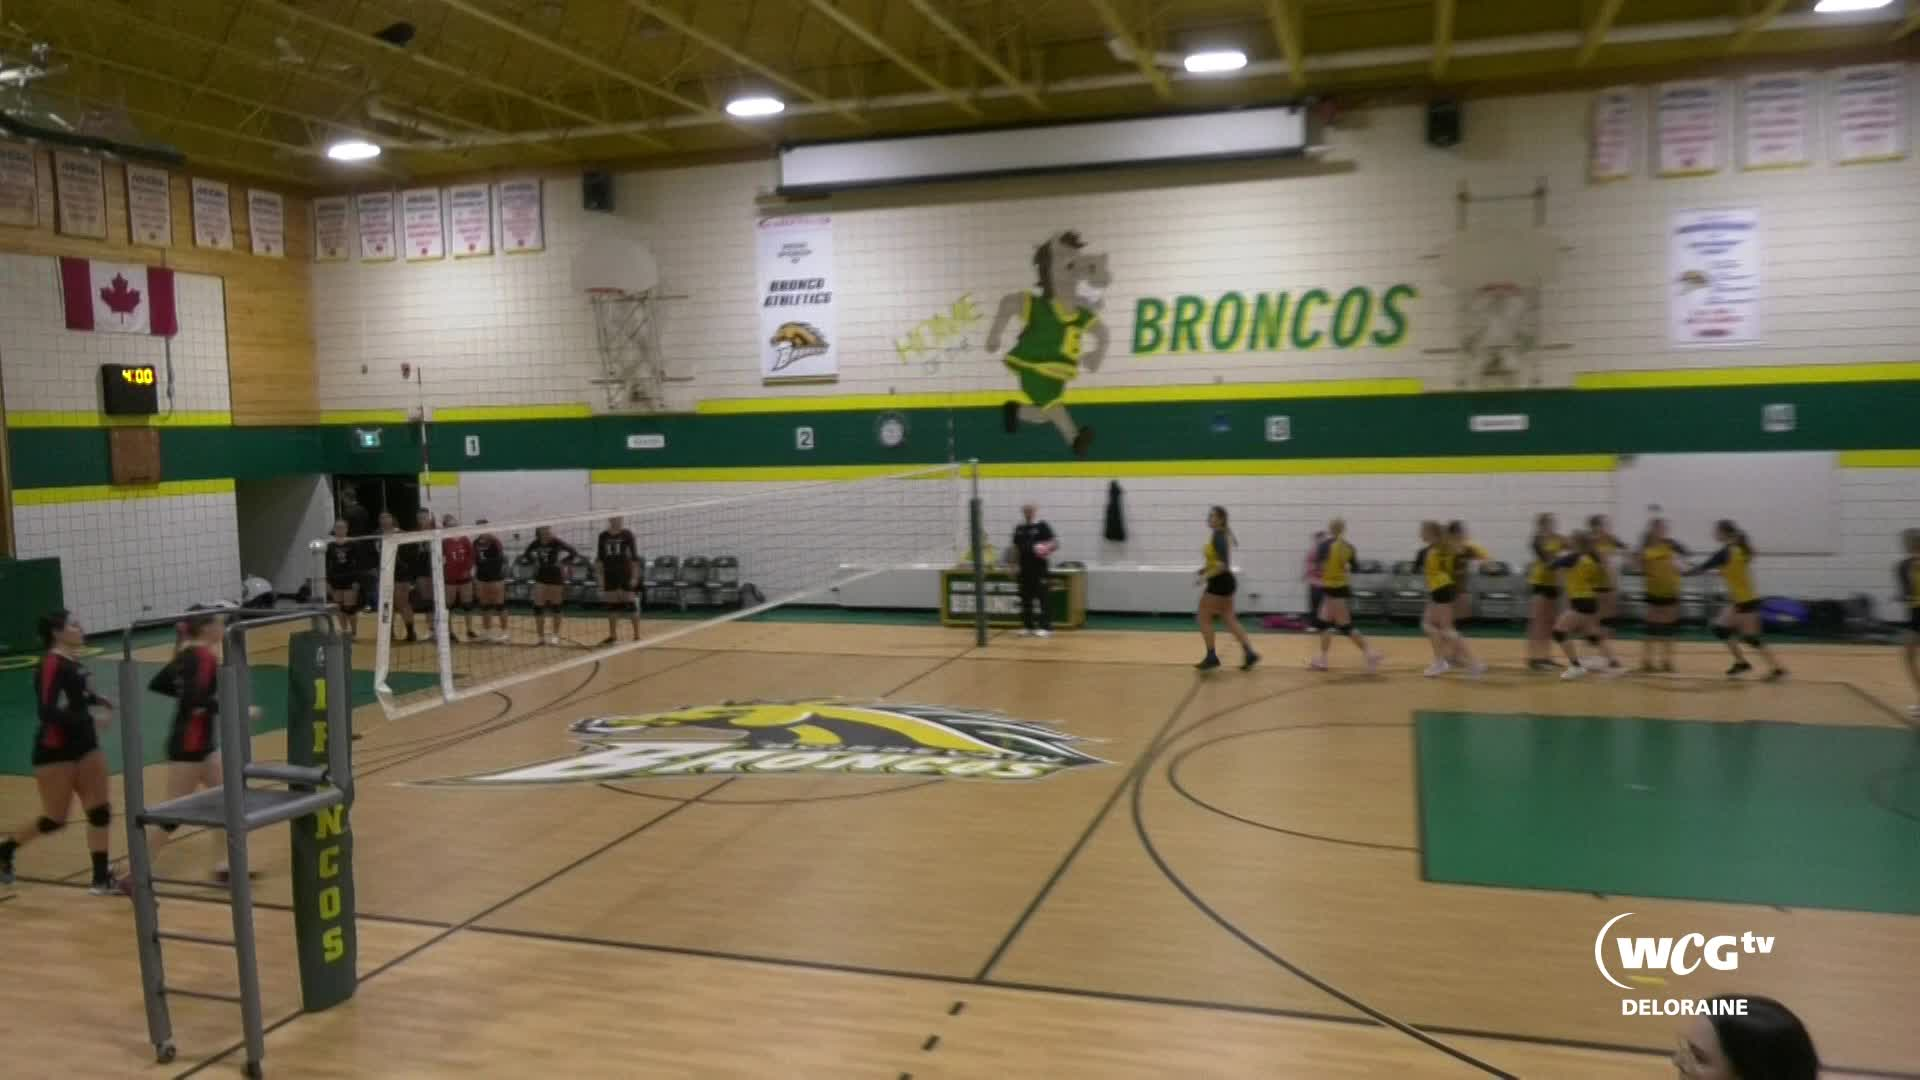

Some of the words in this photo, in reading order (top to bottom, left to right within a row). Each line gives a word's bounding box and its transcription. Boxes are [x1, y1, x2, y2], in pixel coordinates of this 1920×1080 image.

[769, 278, 825, 292] BRONCO
[763, 291, 833, 308] ATHLETICS
[1132, 284, 1419, 358] BRONCOS
[799, 431, 811, 446] 2
[311, 678, 345, 965] RNCOS
